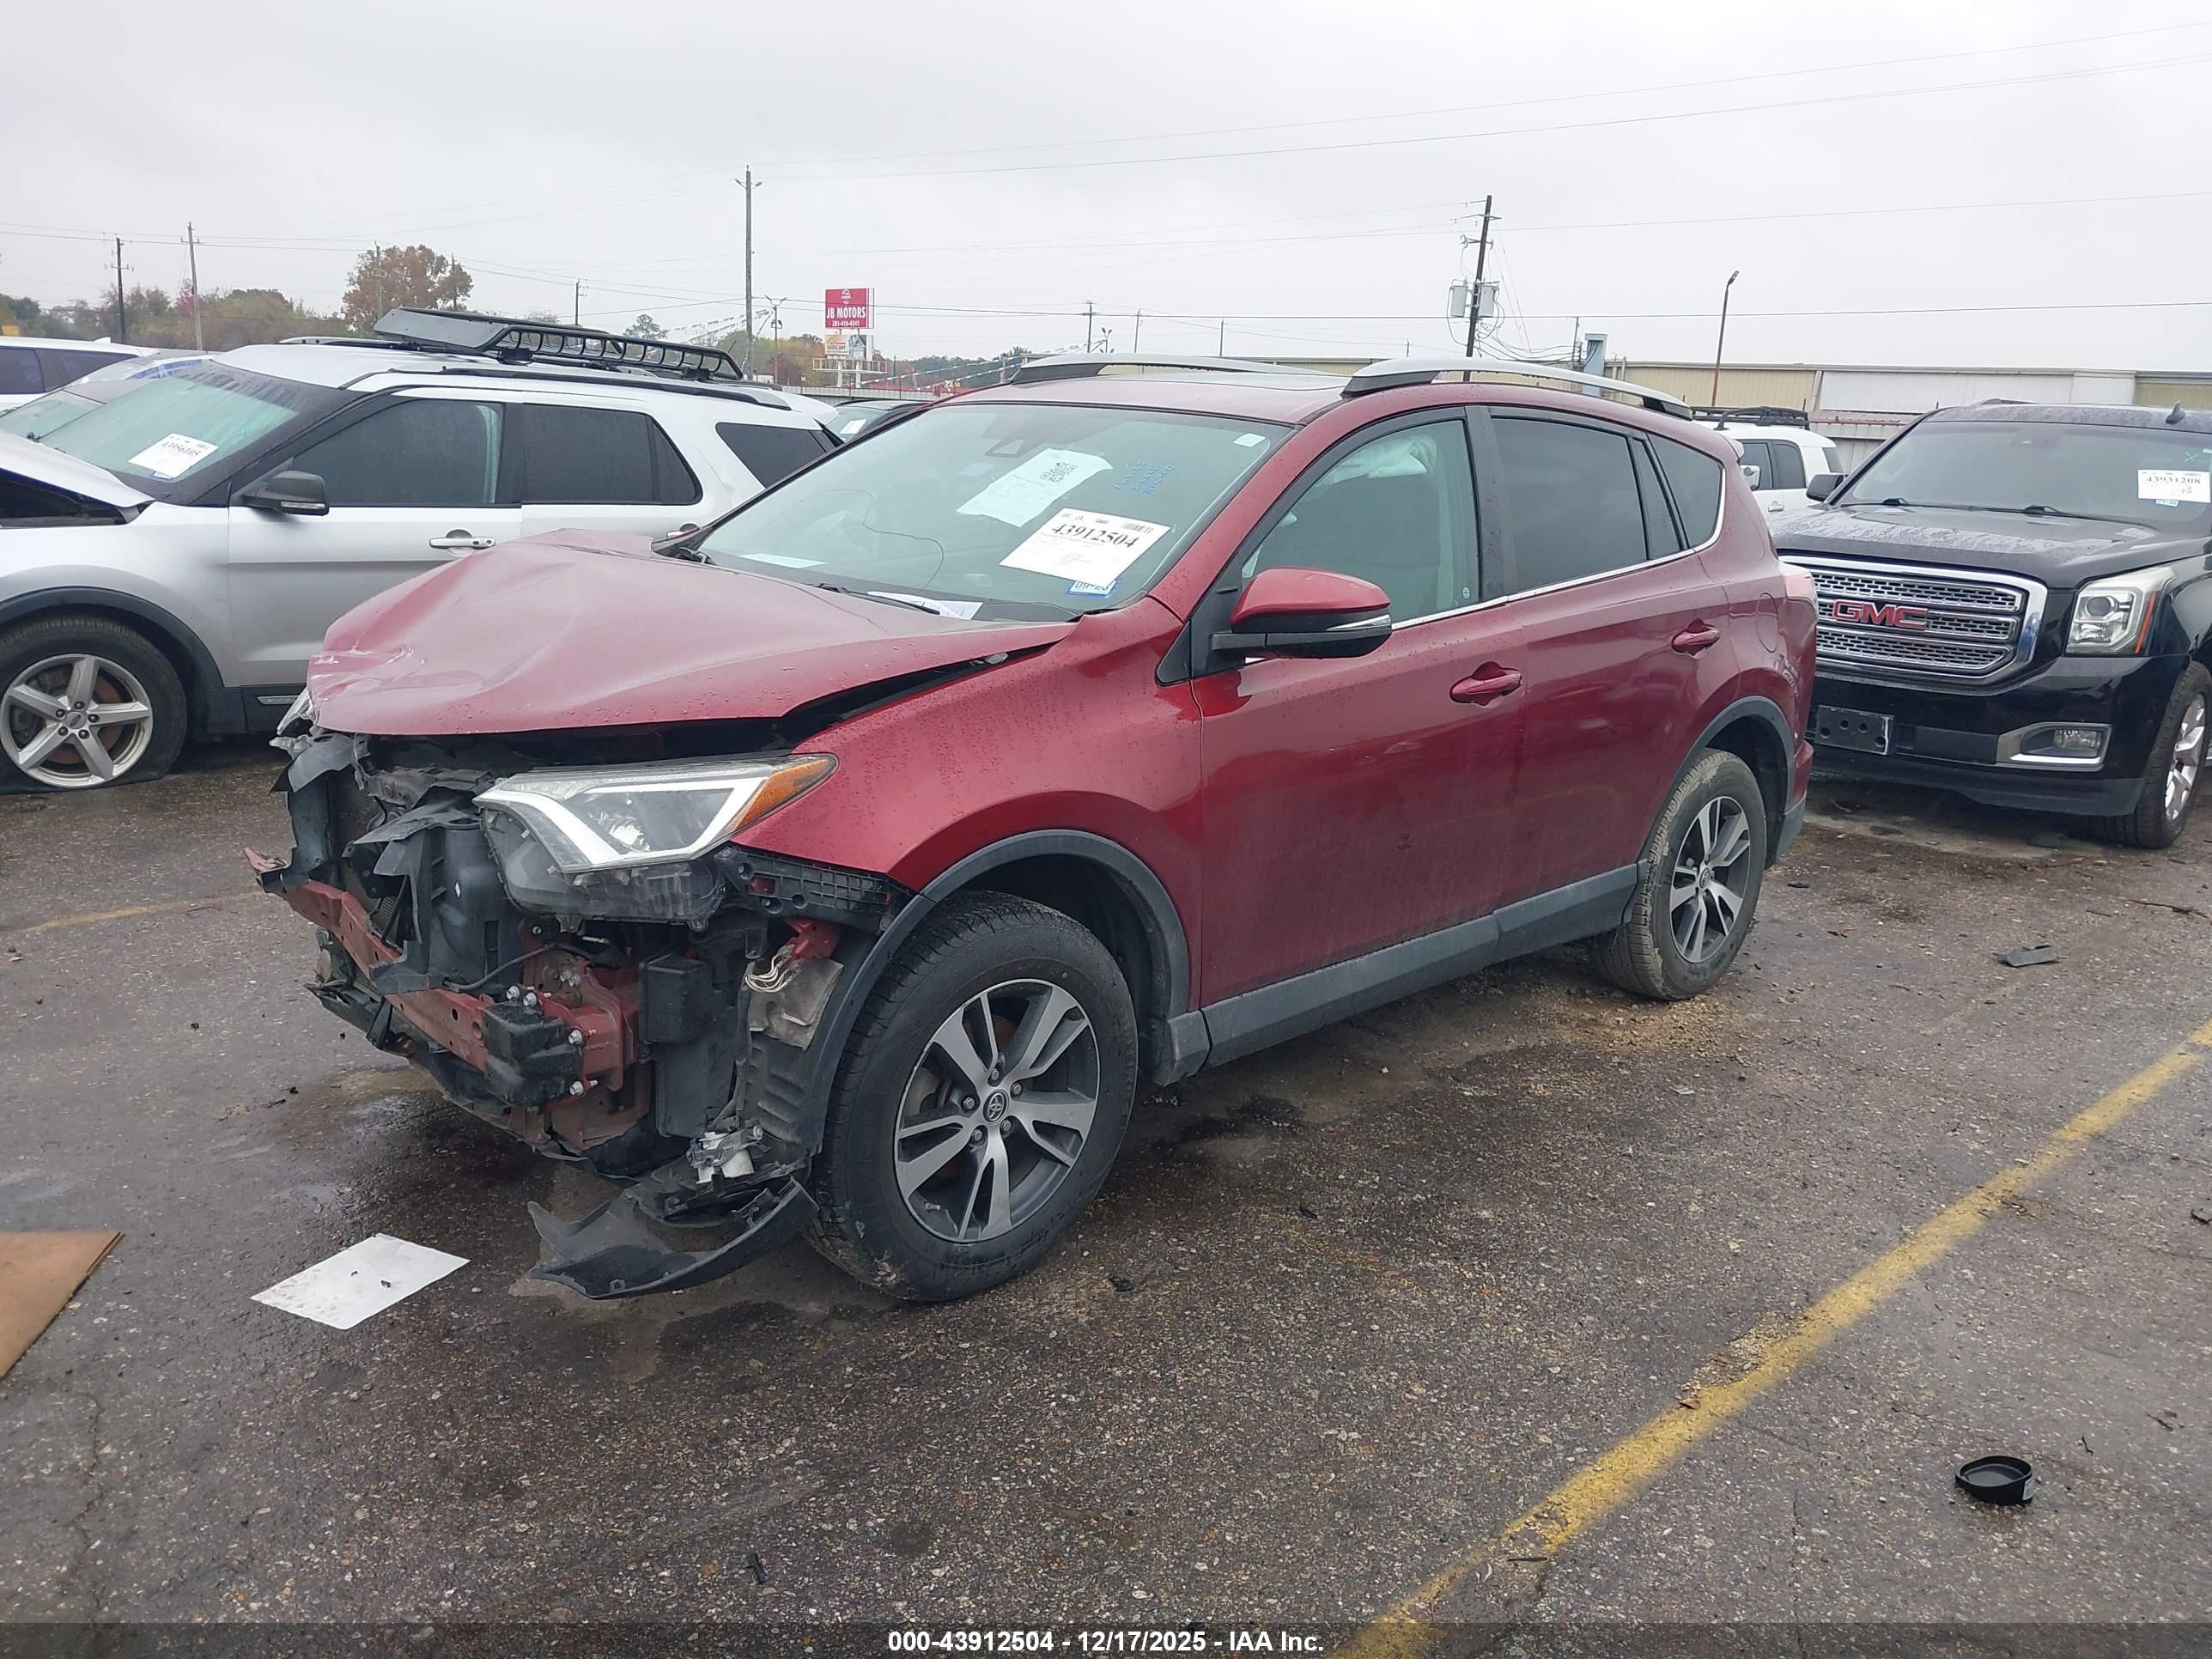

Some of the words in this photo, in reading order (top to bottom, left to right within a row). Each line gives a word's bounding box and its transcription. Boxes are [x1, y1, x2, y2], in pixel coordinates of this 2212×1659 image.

[826, 307, 836, 319] JB
[836, 306, 866, 319] MOTORS
[1051, 523, 1140, 548] 43912504
[1832, 599, 1929, 631] GMC
